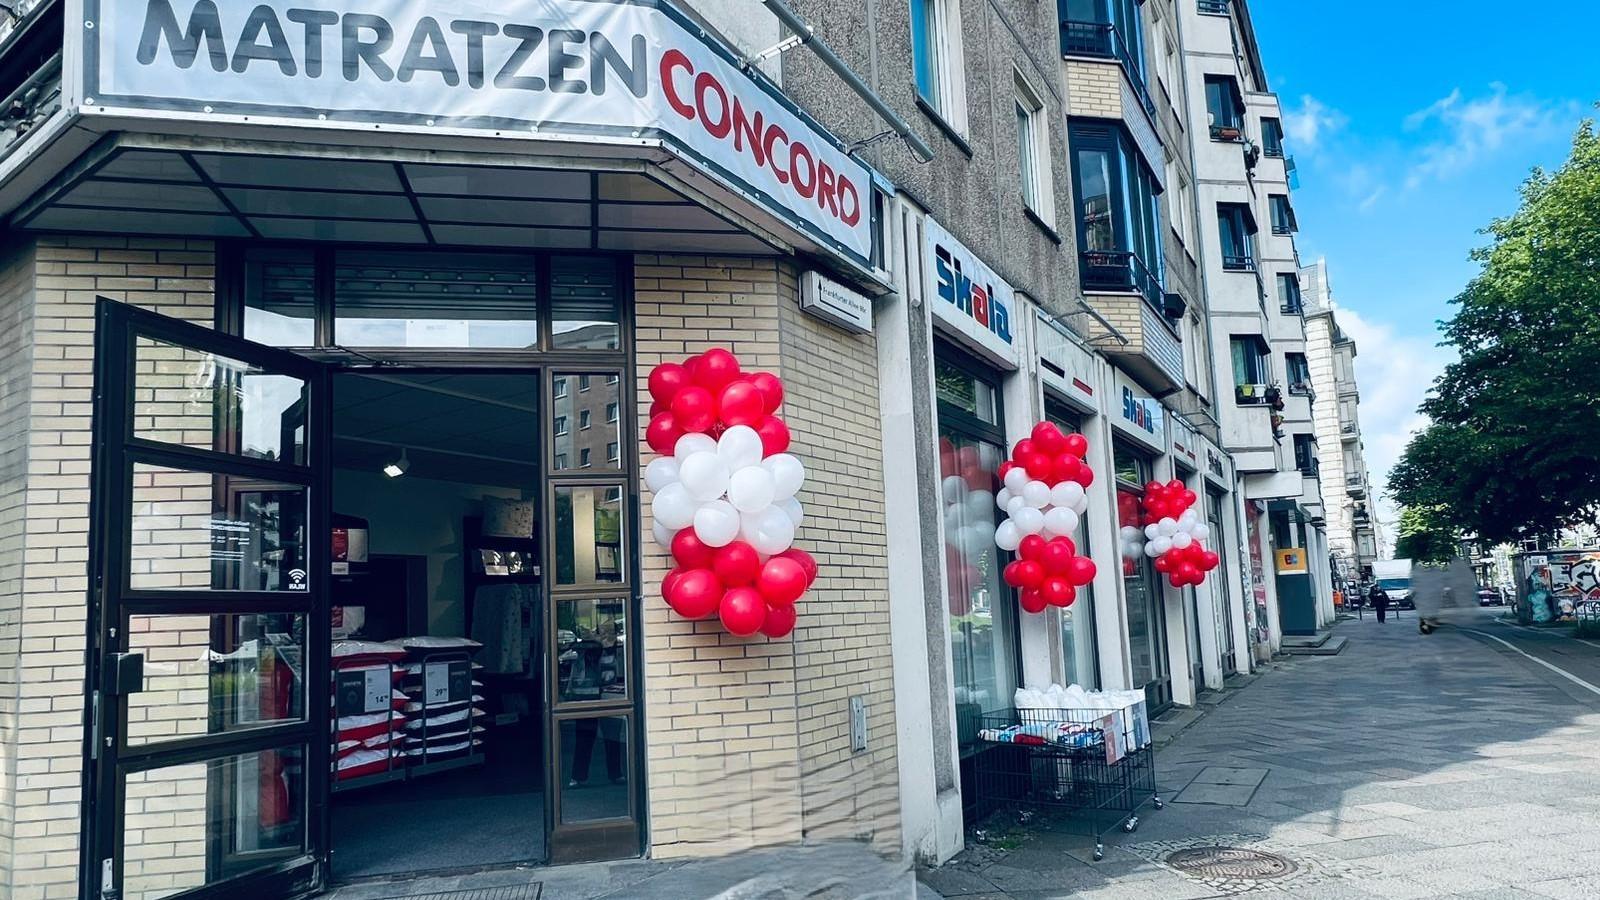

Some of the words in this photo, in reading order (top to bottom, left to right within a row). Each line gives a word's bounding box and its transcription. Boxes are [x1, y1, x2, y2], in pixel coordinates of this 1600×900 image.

[136, 0, 648, 98] MATRATZEN
[659, 48, 860, 227] CONCORD
[935, 243, 1013, 345] Skala
[1122, 385, 1154, 434] Skala
